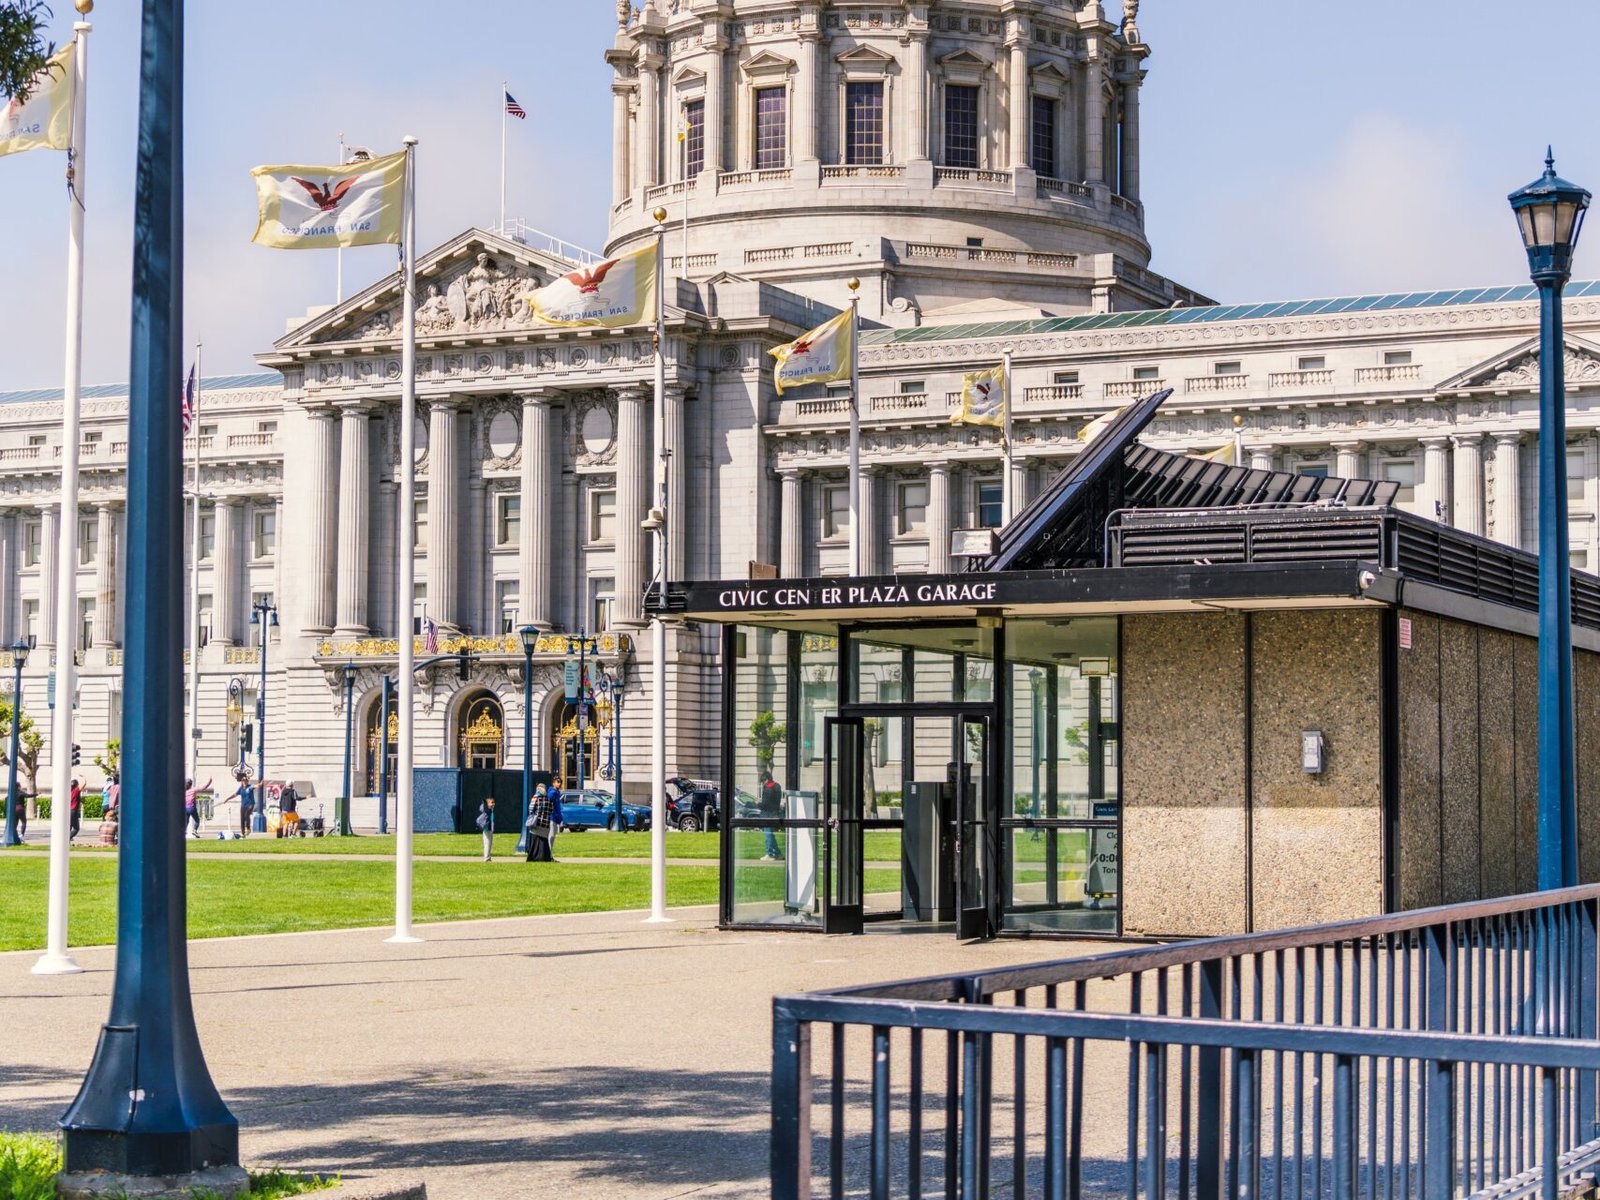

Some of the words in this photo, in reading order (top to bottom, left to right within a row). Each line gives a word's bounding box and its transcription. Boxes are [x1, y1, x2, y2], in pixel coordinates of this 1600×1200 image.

[719, 589, 769, 607] CIVIC
[848, 585, 910, 603] PLAZA
[917, 583, 997, 601] GARAGE
